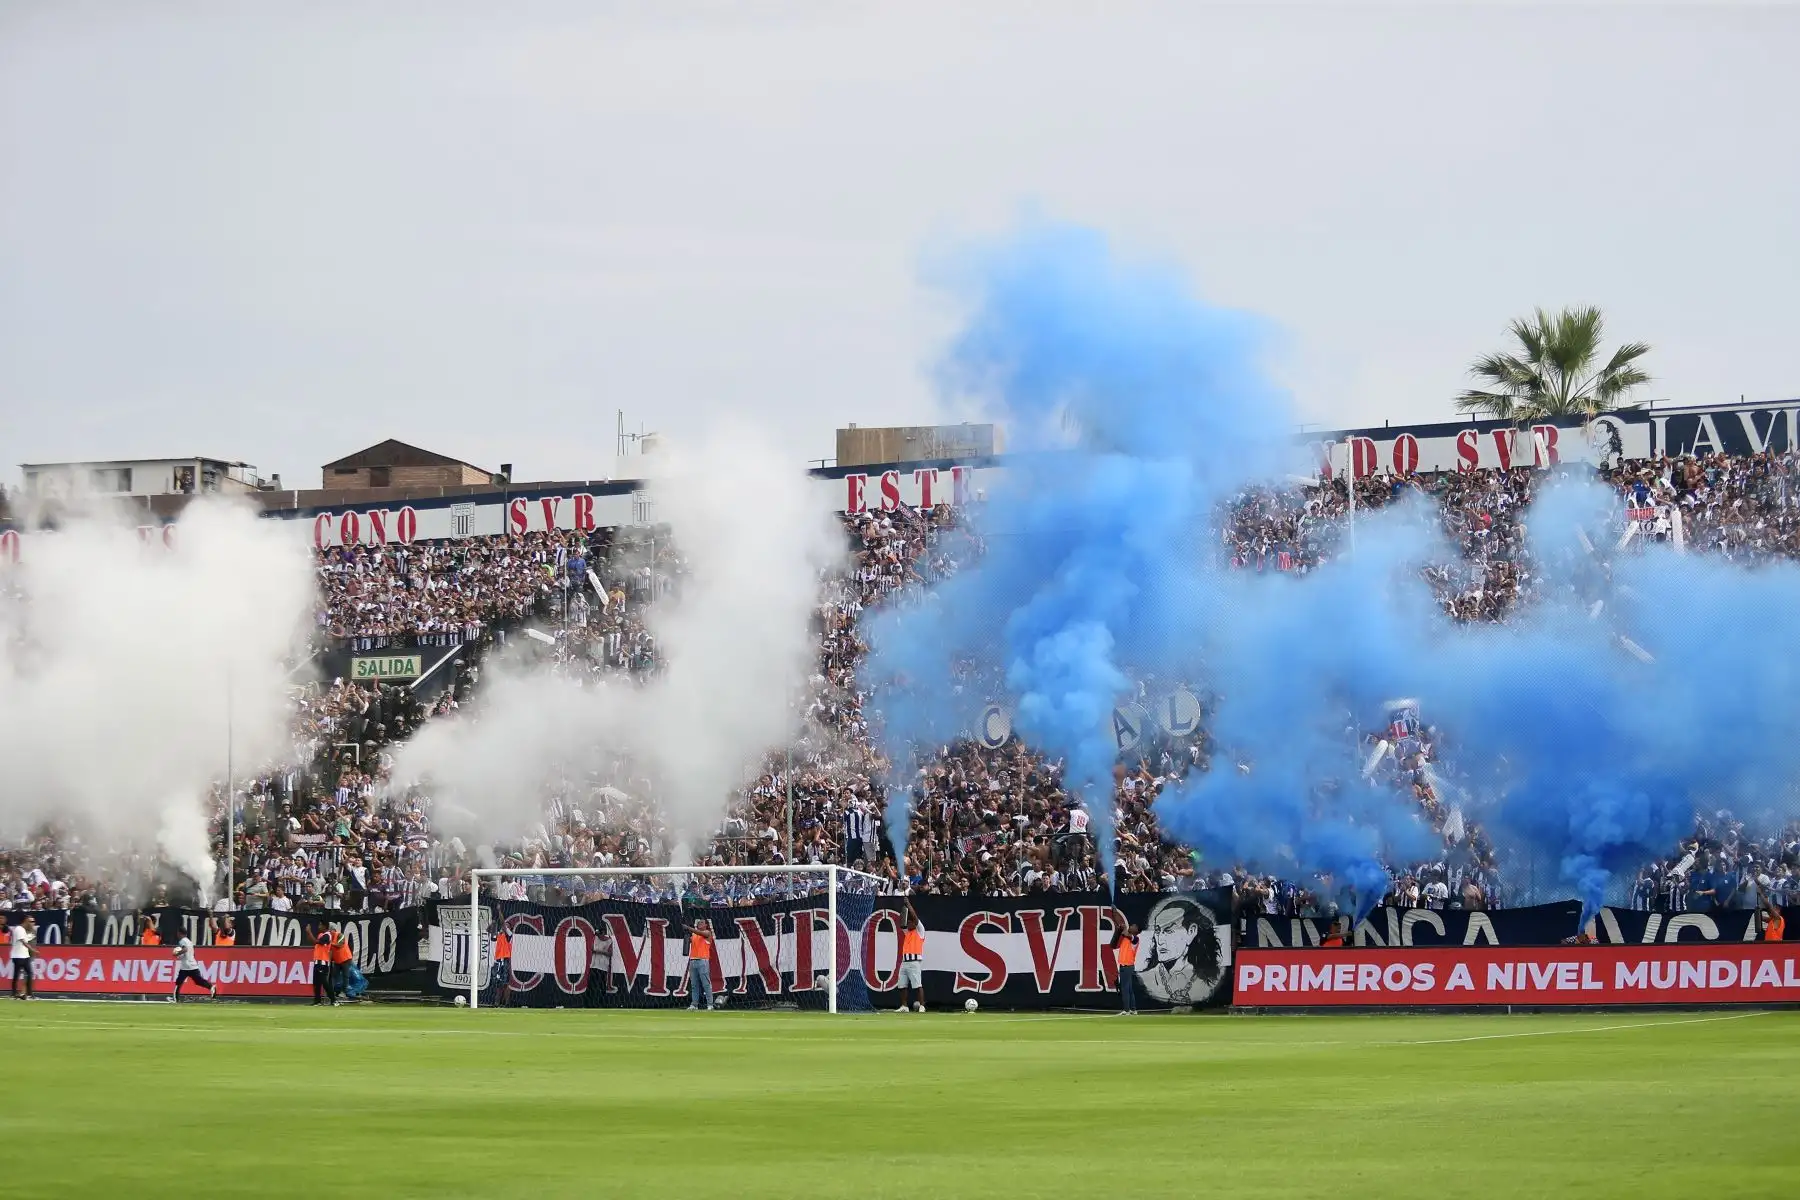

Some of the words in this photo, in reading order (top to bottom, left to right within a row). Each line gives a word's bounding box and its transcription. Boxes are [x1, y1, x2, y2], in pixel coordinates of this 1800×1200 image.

[313, 504, 417, 552] CONO
[508, 492, 597, 538] SVR
[357, 657, 415, 678] SALIDA
[444, 931, 453, 961] CLUB
[481, 931, 490, 961] LIMA
[84, 958, 105, 981] A
[1238, 963, 1436, 993] PRIMEROS
[1445, 963, 1475, 991] A
[1486, 962, 1604, 991] NIVEL
[1614, 959, 1800, 989] MUNDIAL
